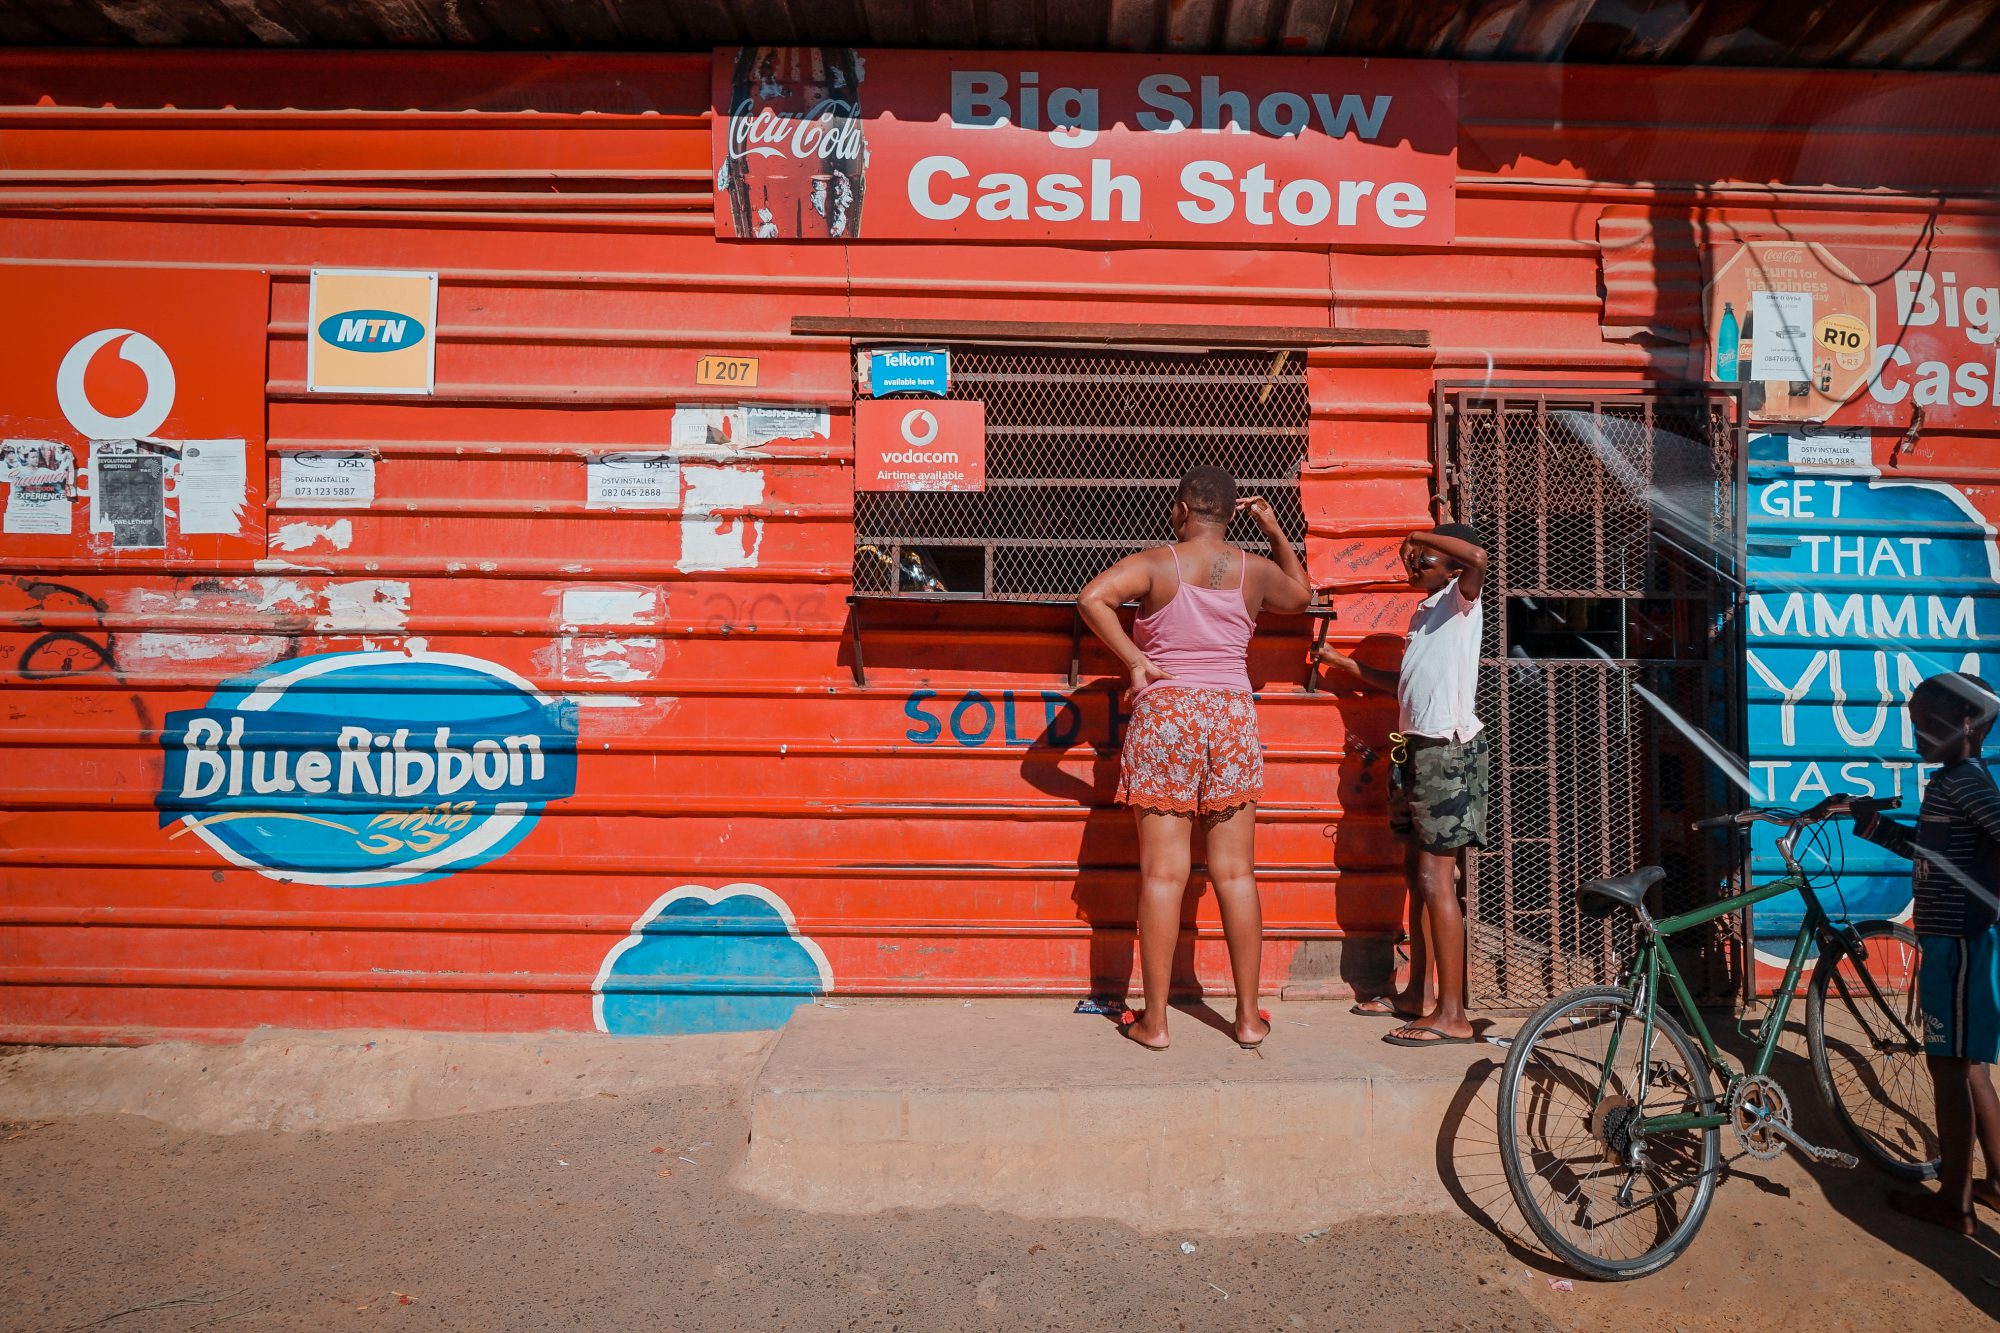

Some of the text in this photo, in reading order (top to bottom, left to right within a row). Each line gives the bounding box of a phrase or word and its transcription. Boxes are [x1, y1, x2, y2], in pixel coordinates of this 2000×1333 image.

[951, 70, 1393, 148] Big Show
[907, 155, 1428, 228] Cash Store
[1744, 265, 1818, 278] return for
[1746, 278, 1828, 292] happiness
[337, 318, 407, 343] MTN
[1823, 327, 1861, 348] R10
[883, 352, 935, 367] Telkom
[716, 361, 750, 380] 207
[1866, 344, 2000, 407] Cas
[883, 378, 935, 386] available here
[881, 448, 959, 464] vodacom
[1818, 446, 1850, 454] INSTALLER
[337, 459, 367, 468] DStv
[1801, 457, 1816, 465] 082
[1818, 457, 1834, 465] 045
[877, 470, 965, 480] Airtime available
[15, 492, 65, 500] EXPERIENCE
[295, 487, 355, 496] 073 123 5887
[601, 488, 661, 497] 082 045 2888
[1760, 479, 1852, 518] GET
[1797, 535, 1932, 578] THAT
[1748, 591, 1980, 640] MMMM
[905, 690, 1082, 747] SOLD
